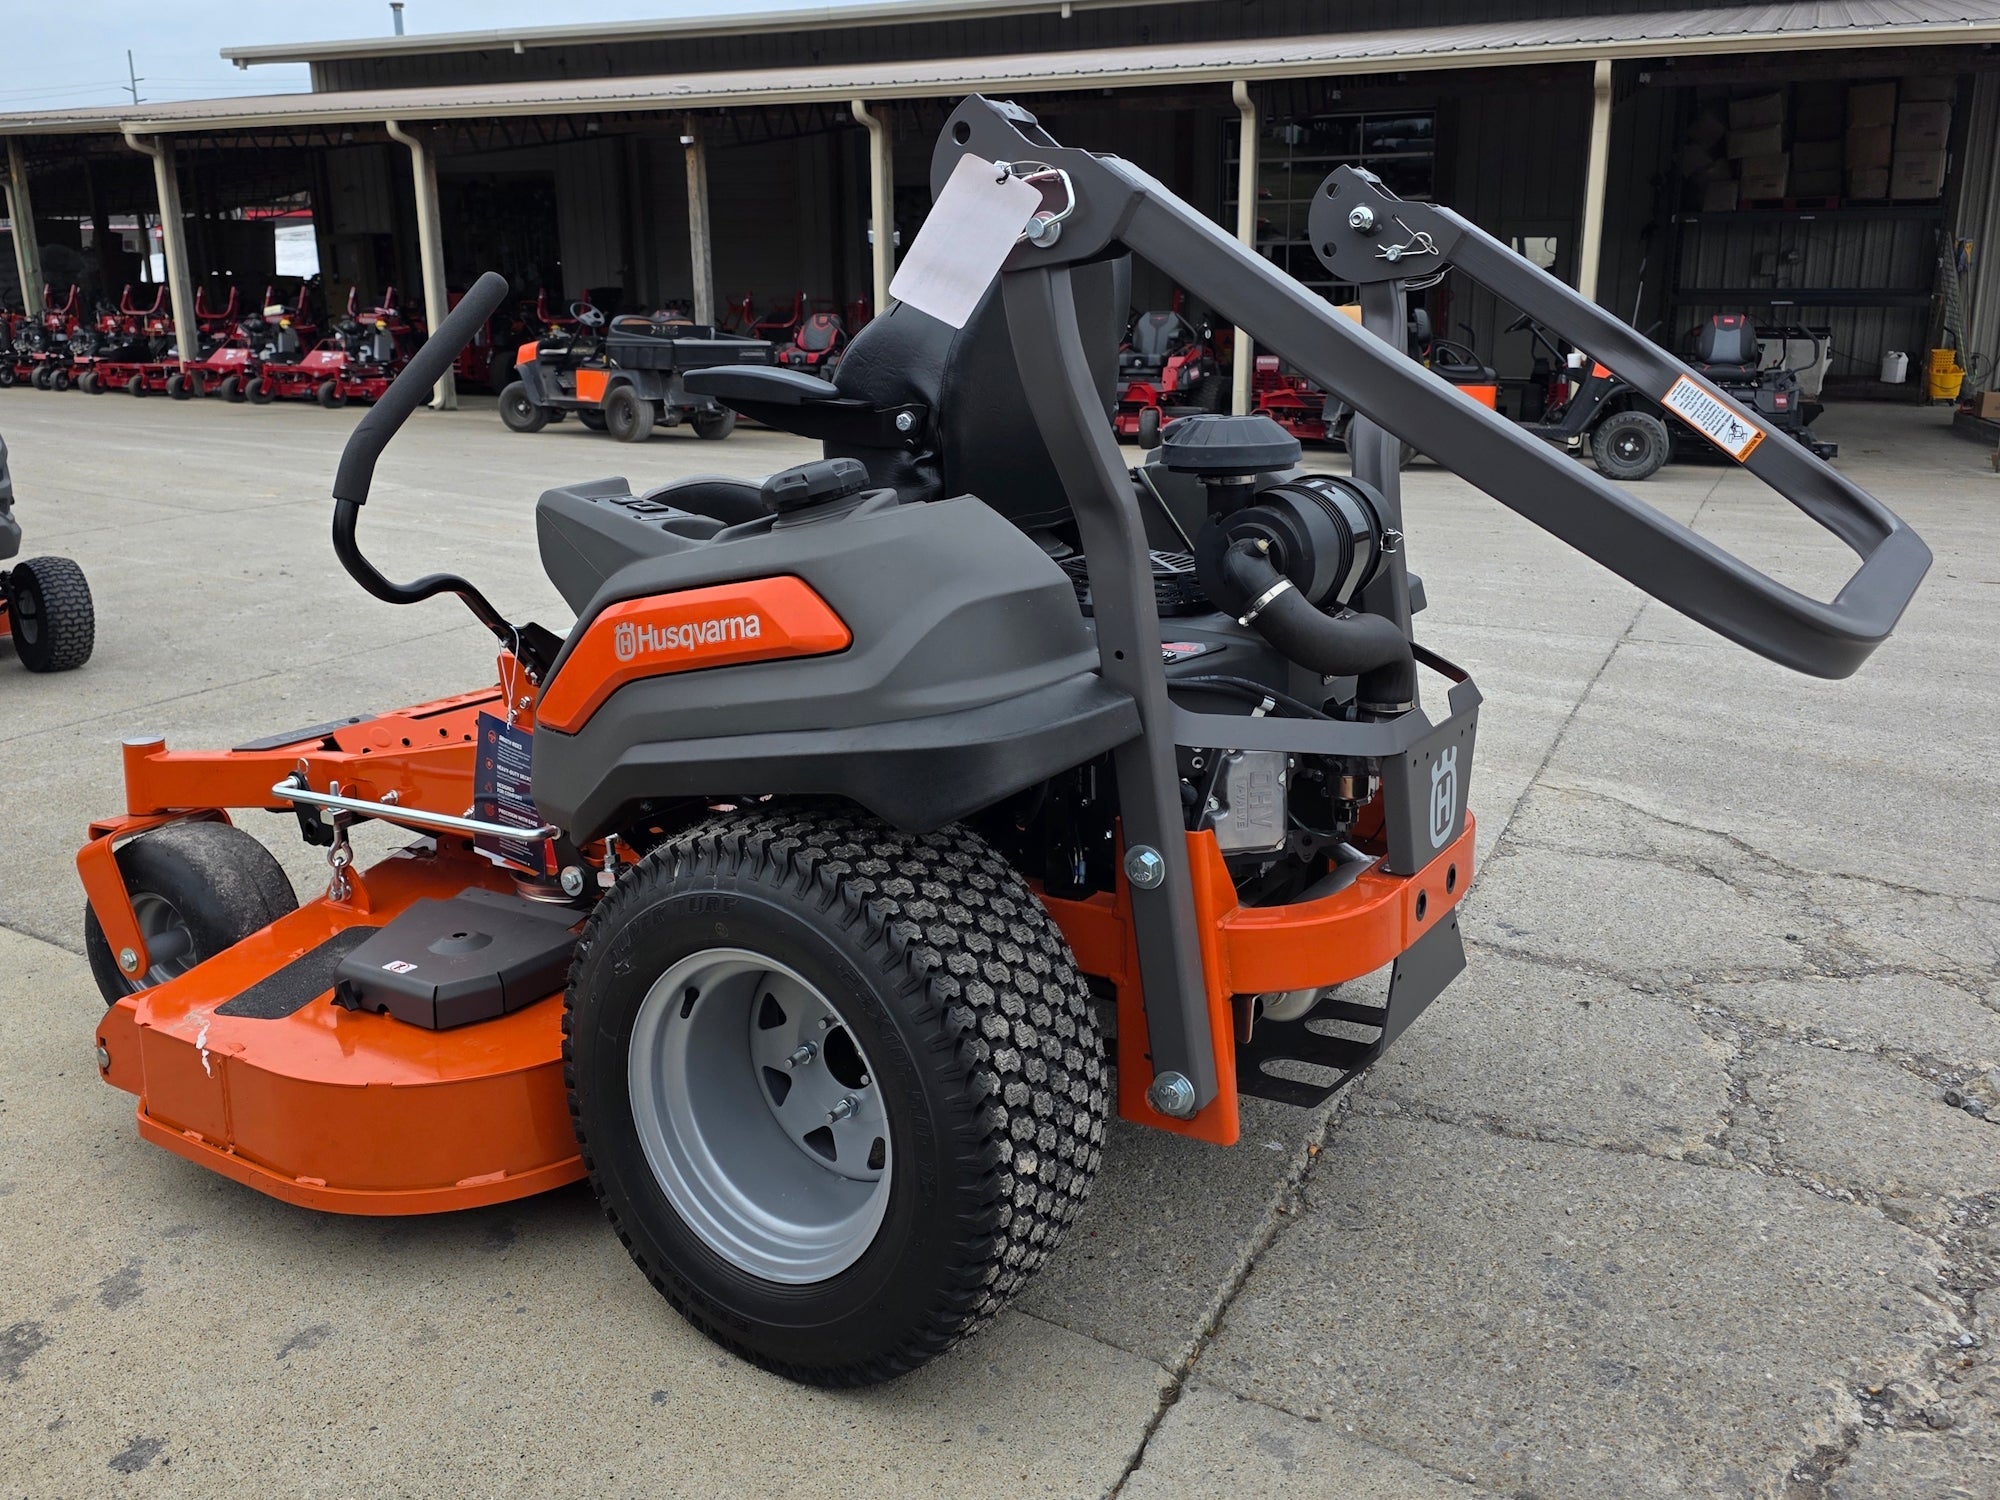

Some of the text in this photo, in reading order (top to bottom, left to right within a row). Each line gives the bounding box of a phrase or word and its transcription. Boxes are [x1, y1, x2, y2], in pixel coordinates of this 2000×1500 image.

[637, 614, 761, 653] Husqvarna
[1250, 770, 1273, 828] OHV
[674, 896, 741, 917] TURF
